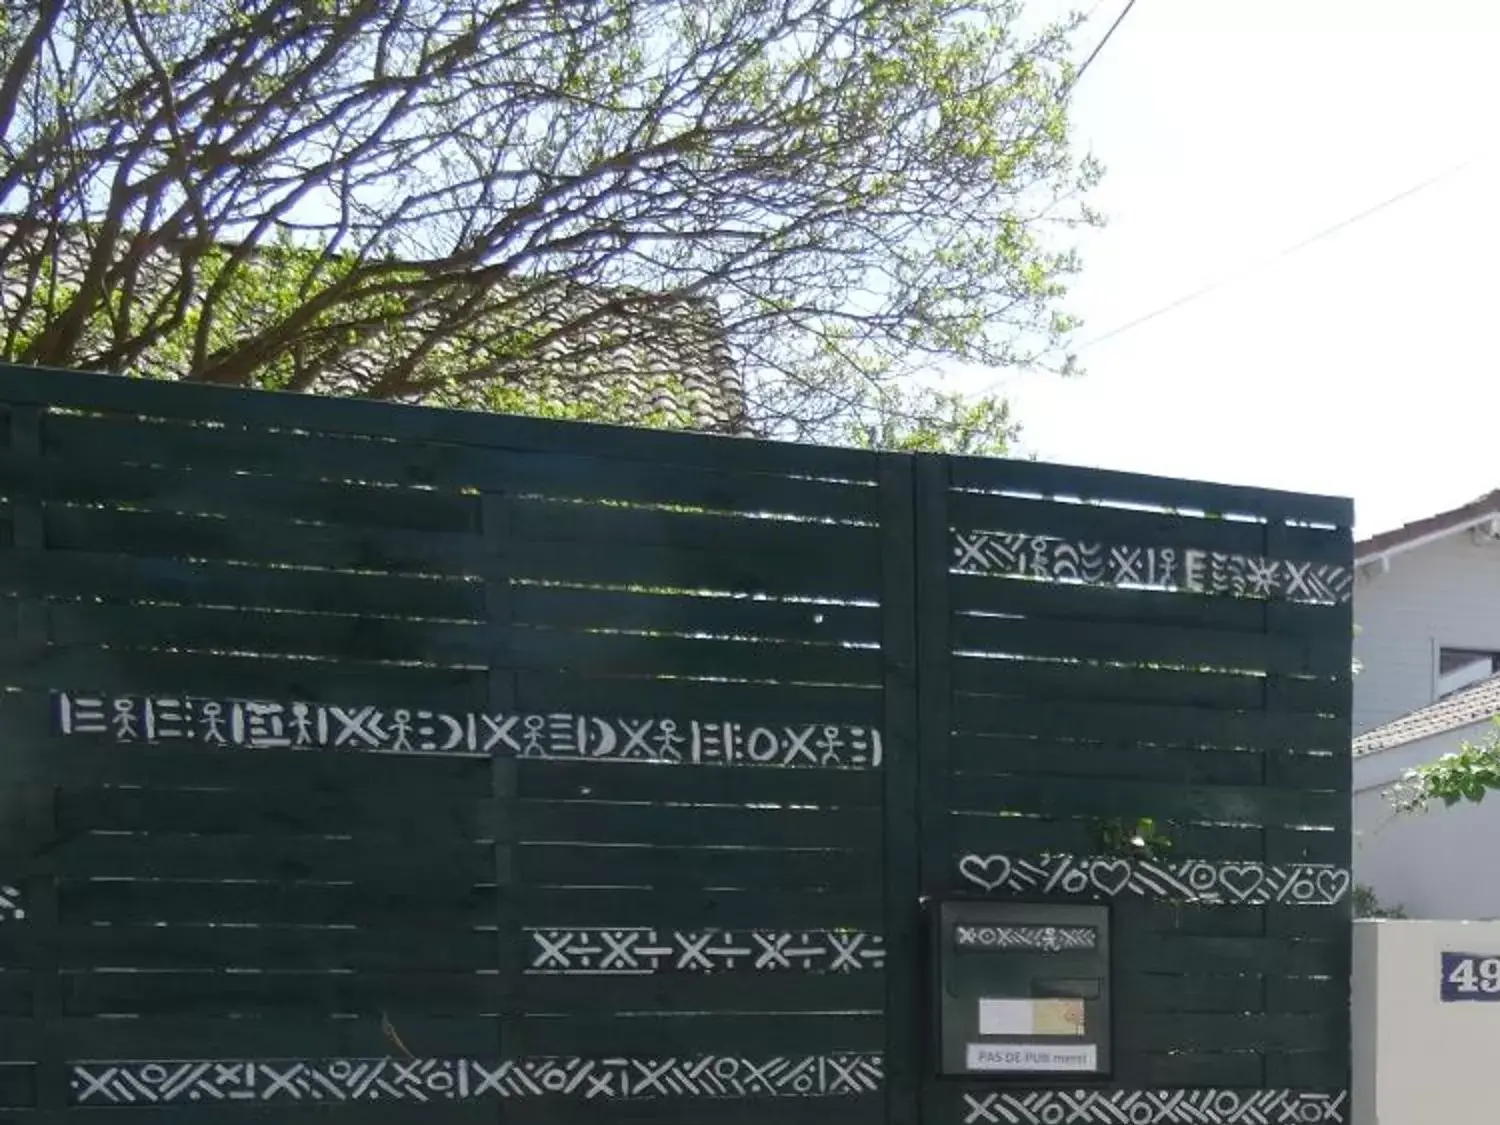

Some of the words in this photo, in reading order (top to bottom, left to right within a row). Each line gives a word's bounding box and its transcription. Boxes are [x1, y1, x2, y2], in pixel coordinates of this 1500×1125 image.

[978, 1050, 1004, 1063] PAS
[1005, 1051, 1022, 1064] DE
[1025, 1051, 1050, 1064] PUB
